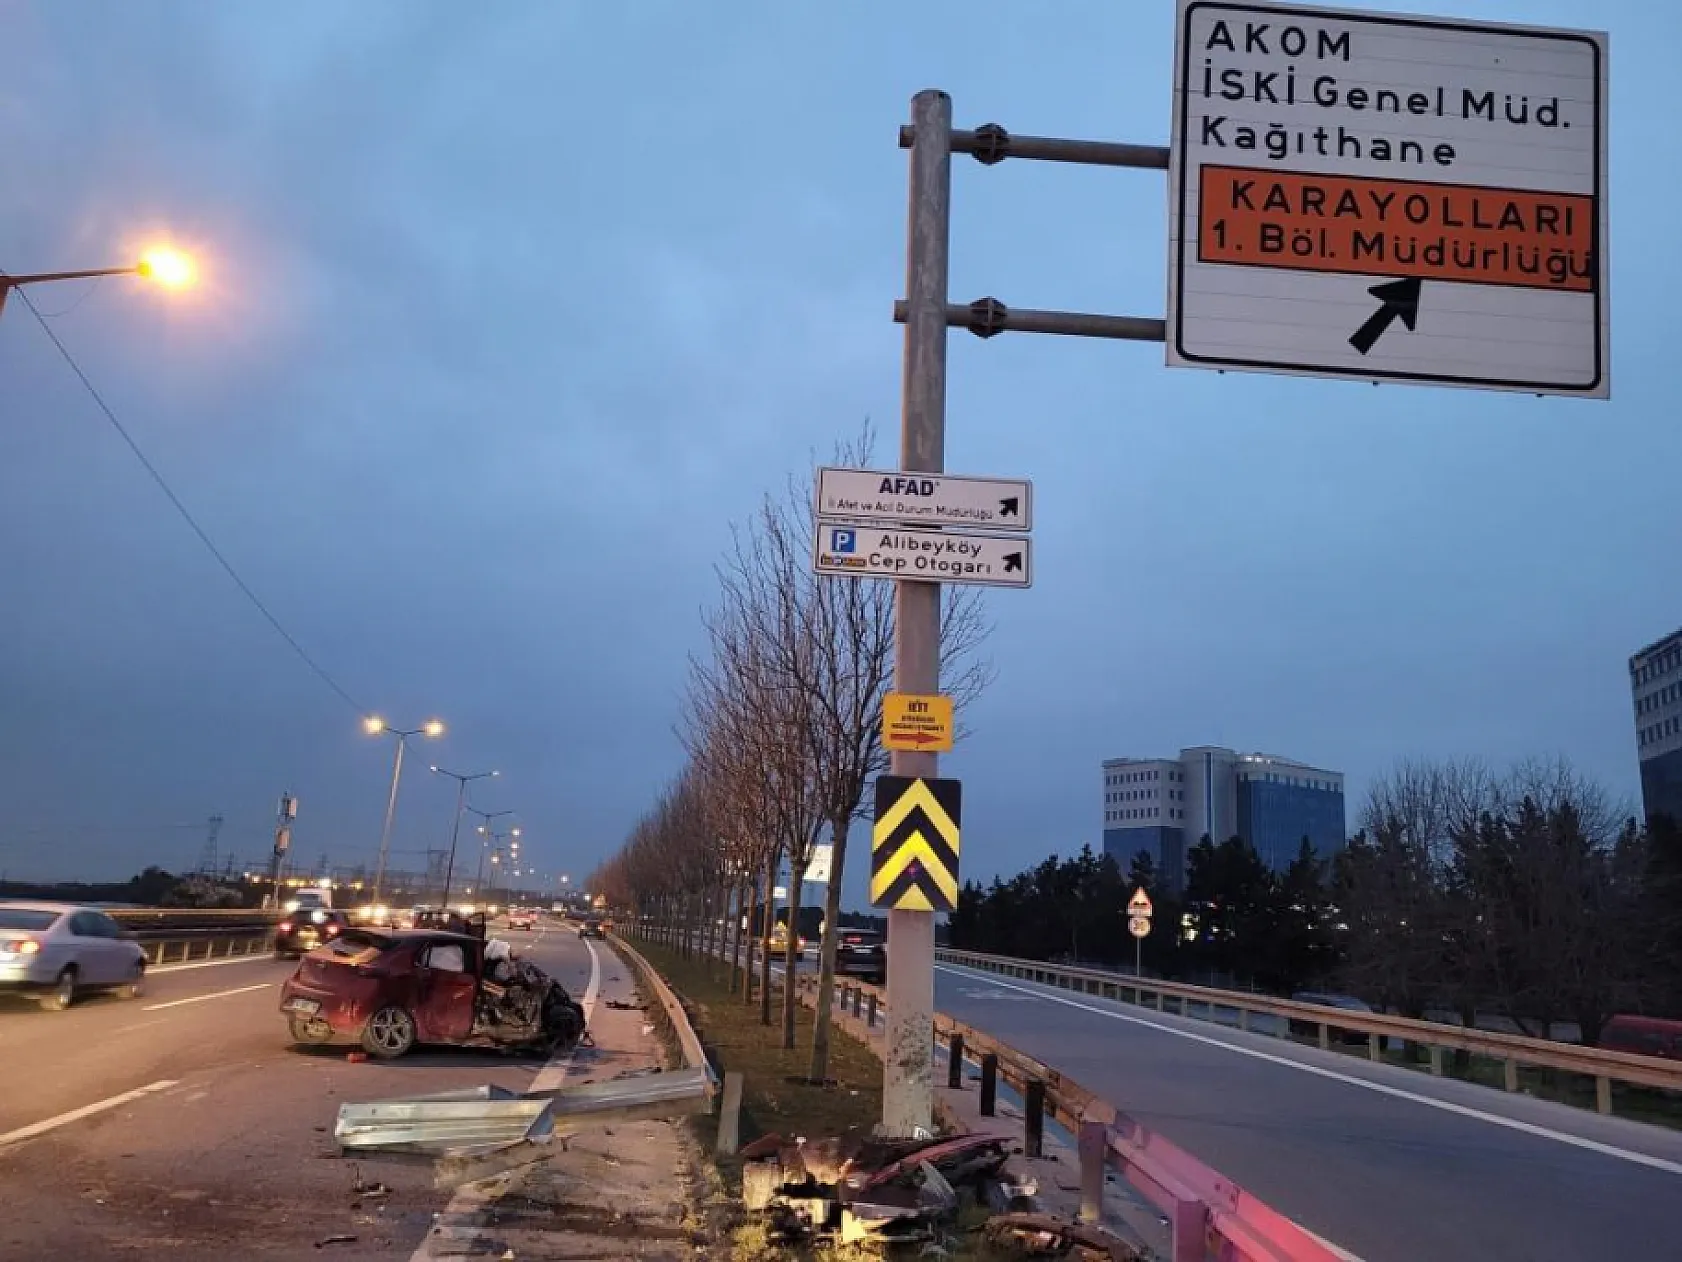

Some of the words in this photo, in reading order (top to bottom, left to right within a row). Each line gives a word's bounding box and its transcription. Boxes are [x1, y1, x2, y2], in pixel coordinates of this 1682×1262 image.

[1206, 20, 1350, 62] AKOM
[1204, 58, 1295, 105] İSKİ
[1313, 75, 1444, 117] Genel
[1462, 88, 1571, 129] Müd.
[1202, 115, 1456, 166] Kağıthane
[1232, 179, 1573, 236] KARAYOLLARI
[1212, 219, 1242, 251] 1.
[1260, 222, 1337, 259] Böl.
[1352, 230, 1592, 284] Müdürlüğü
[879, 477, 934, 496] AFAD
[836, 533, 849, 551] P
[880, 535, 981, 558] Alibeyköy
[870, 553, 906, 572] Cep
[915, 556, 991, 576] Otogarı
